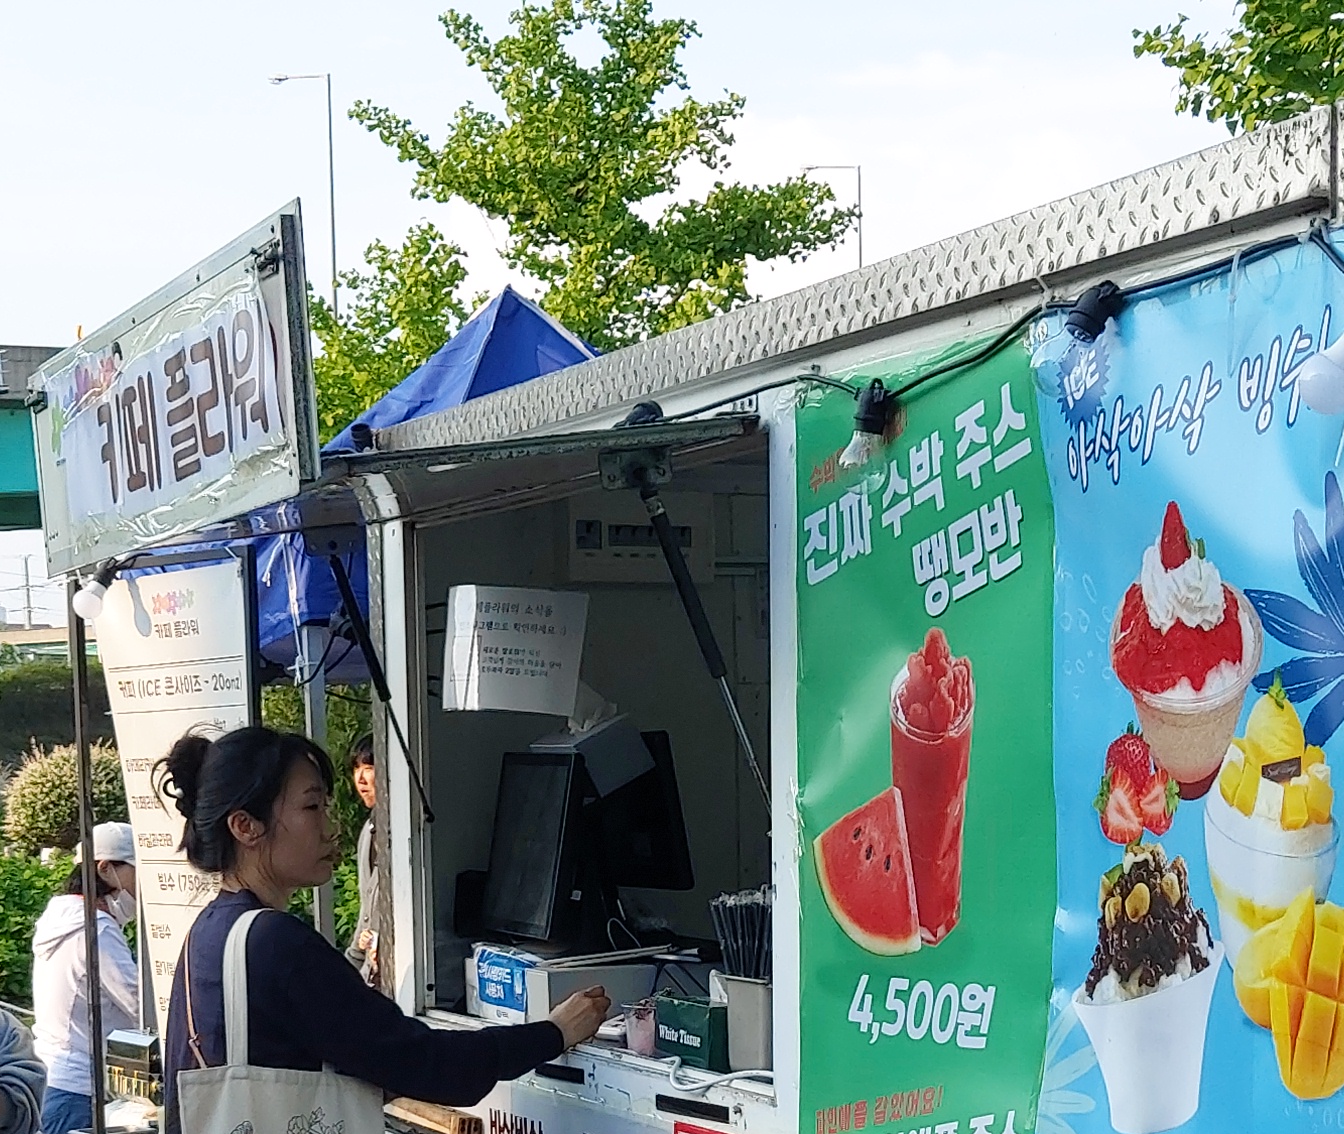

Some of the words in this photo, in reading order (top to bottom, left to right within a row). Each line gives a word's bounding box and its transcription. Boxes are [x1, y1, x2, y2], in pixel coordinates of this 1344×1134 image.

[97, 370, 162, 503] 카페
[164, 300, 271, 483] 플라워
[1063, 347, 1102, 409] ICE
[1066, 360, 1223, 494] 아삭아삭
[803, 481, 873, 587] 진짜
[881, 430, 946, 539] 수박
[955, 382, 1033, 490] 주스
[911, 489, 1024, 619] 땡모반
[154, 622, 172, 639] 카페
[658, 1023, 679, 1042] White
[679, 1028, 701, 1048] Tissue
[847, 973, 998, 1050] 4,500원
